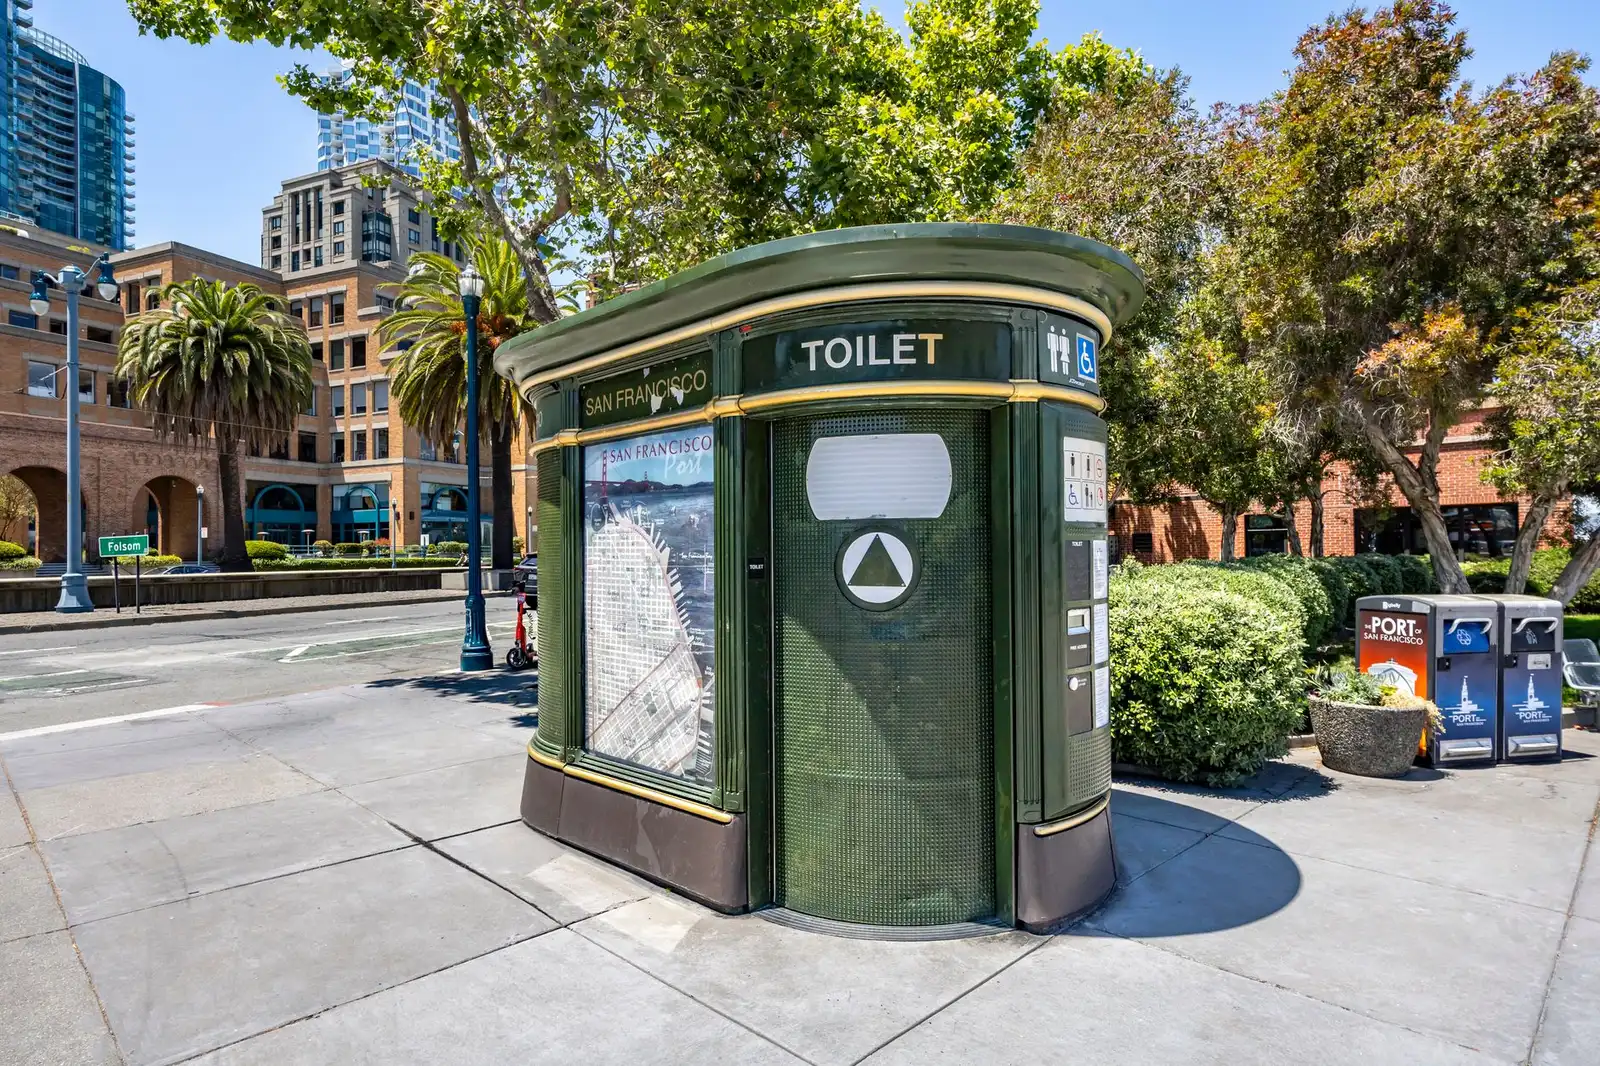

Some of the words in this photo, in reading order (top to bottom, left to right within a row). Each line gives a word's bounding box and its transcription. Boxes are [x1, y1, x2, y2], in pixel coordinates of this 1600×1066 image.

[801, 333, 943, 371] TOILET
[585, 392, 613, 416] SAN
[616, 369, 707, 409] FRANCISCO
[610, 447, 632, 464] SAN
[636, 435, 711, 459] FRANCISCO
[664, 448, 704, 479] Port
[108, 541, 141, 551] Folsom
[1371, 616, 1416, 637] PORT
[1363, 632, 1379, 641] SAN
[1380, 633, 1424, 646] FRANCISCO
[1452, 714, 1477, 724] PORT
[1519, 711, 1543, 720] PORT
